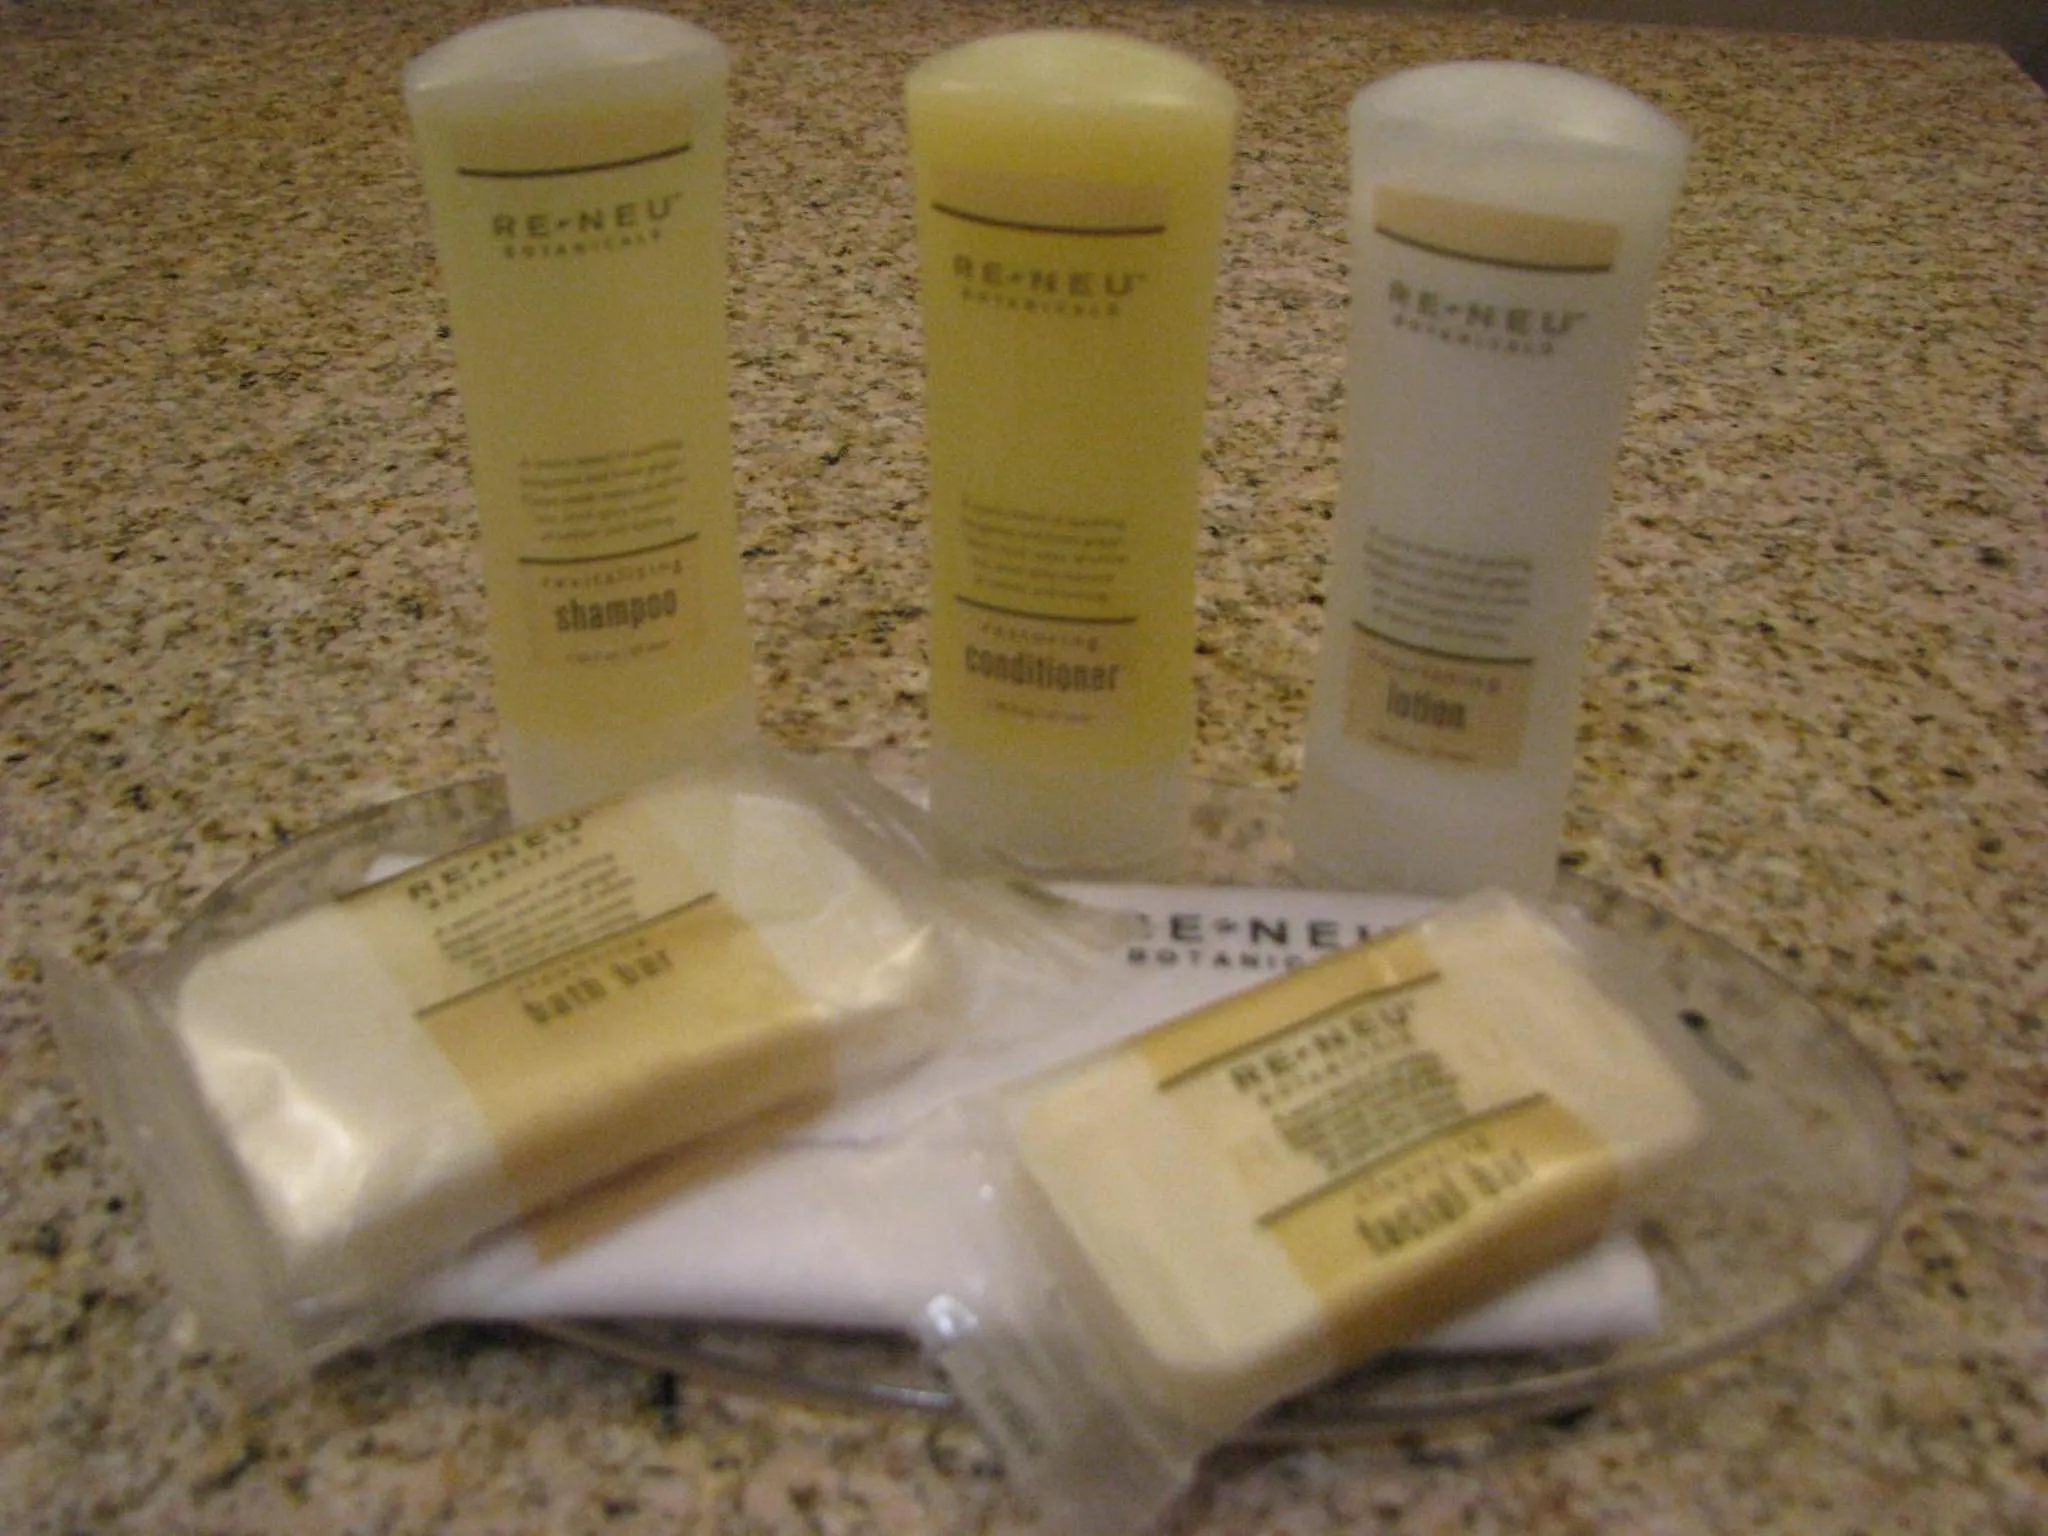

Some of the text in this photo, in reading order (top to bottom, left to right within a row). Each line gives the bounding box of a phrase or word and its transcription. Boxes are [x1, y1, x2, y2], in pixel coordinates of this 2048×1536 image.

[554, 588, 677, 633] shampoo
[964, 645, 1121, 692] conditioner
[1386, 680, 1467, 731] lotion
